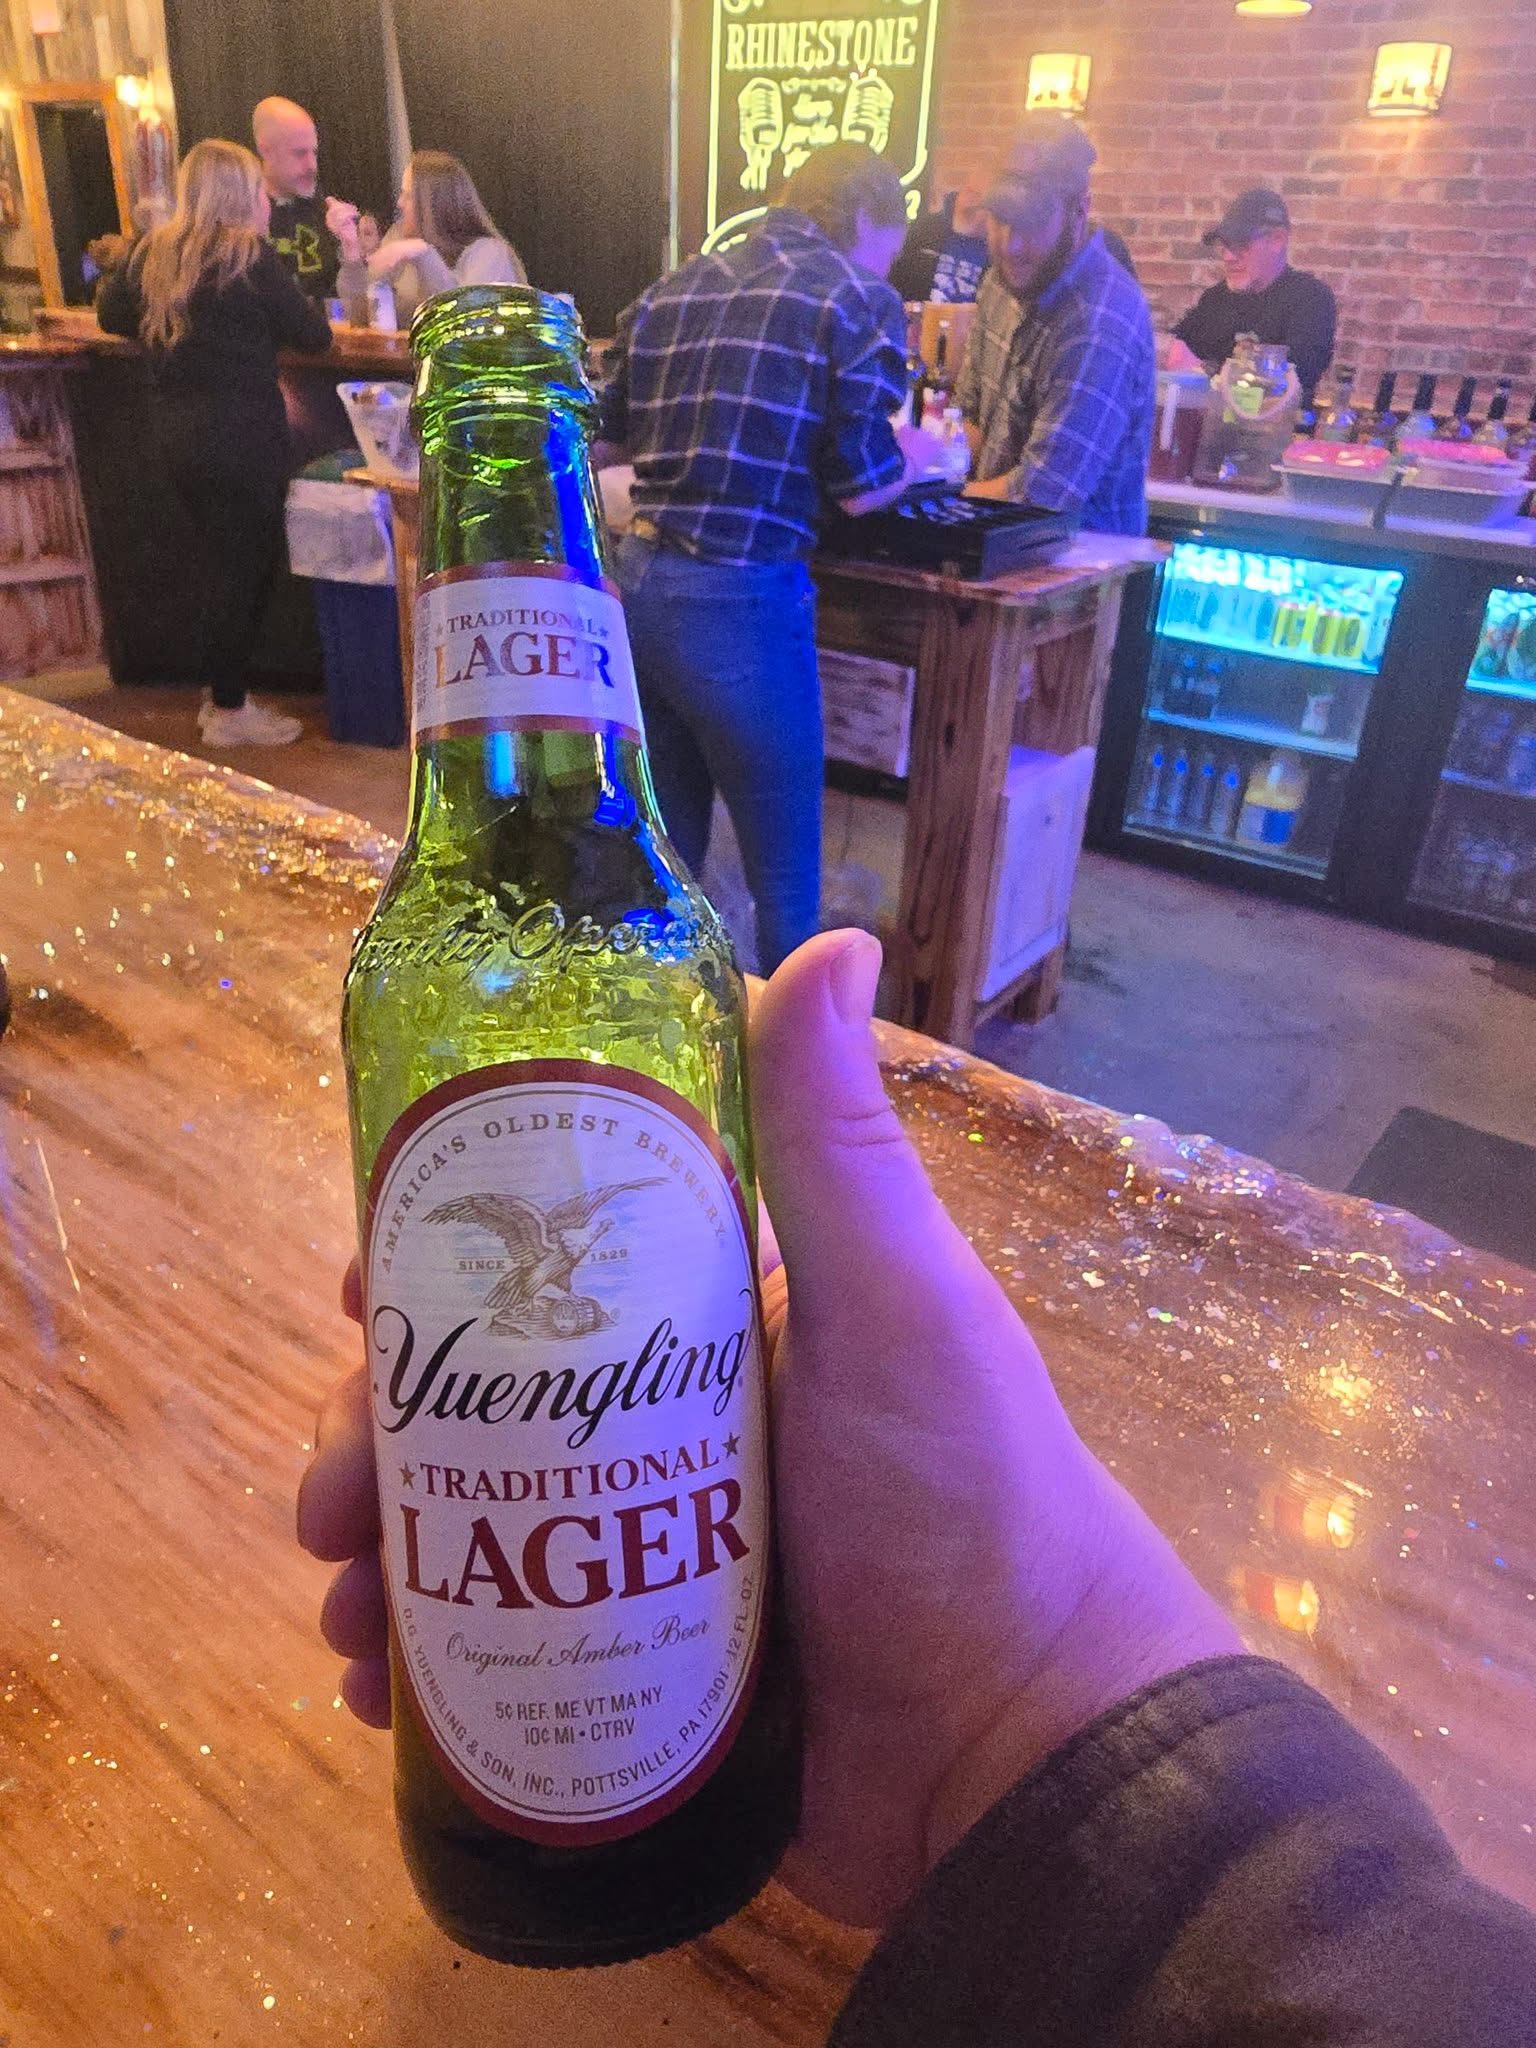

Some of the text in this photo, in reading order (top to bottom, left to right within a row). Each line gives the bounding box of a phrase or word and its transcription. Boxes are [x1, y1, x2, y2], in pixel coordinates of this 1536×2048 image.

[725, 17, 918, 72] RHINESTONE
[446, 607, 598, 635] TRADITIONAL
[434, 632, 615, 689] LAGER
[382, 1112, 727, 1274] AMERICA'S OLDEST BREWERY
[458, 1248, 629, 1272] SINCE 1829
[372, 1288, 754, 1450] Yuengling
[419, 1437, 720, 1502] TRADITIONAL
[399, 1476, 751, 1610] LAGER
[446, 1614, 711, 1676] Original Amber Beer
[413, 1643, 467, 1742] YUENGLING
[466, 1739, 480, 1758] &
[678, 1718, 701, 1743] PA
[698, 1669, 730, 1720] 17901
[726, 1636, 742, 1658] 12
[555, 1700, 580, 1720] ME
[583, 1696, 606, 1717] VT
[611, 1692, 637, 1714] MA
[640, 1684, 663, 1708] NY
[554, 1726, 575, 1745] MI
